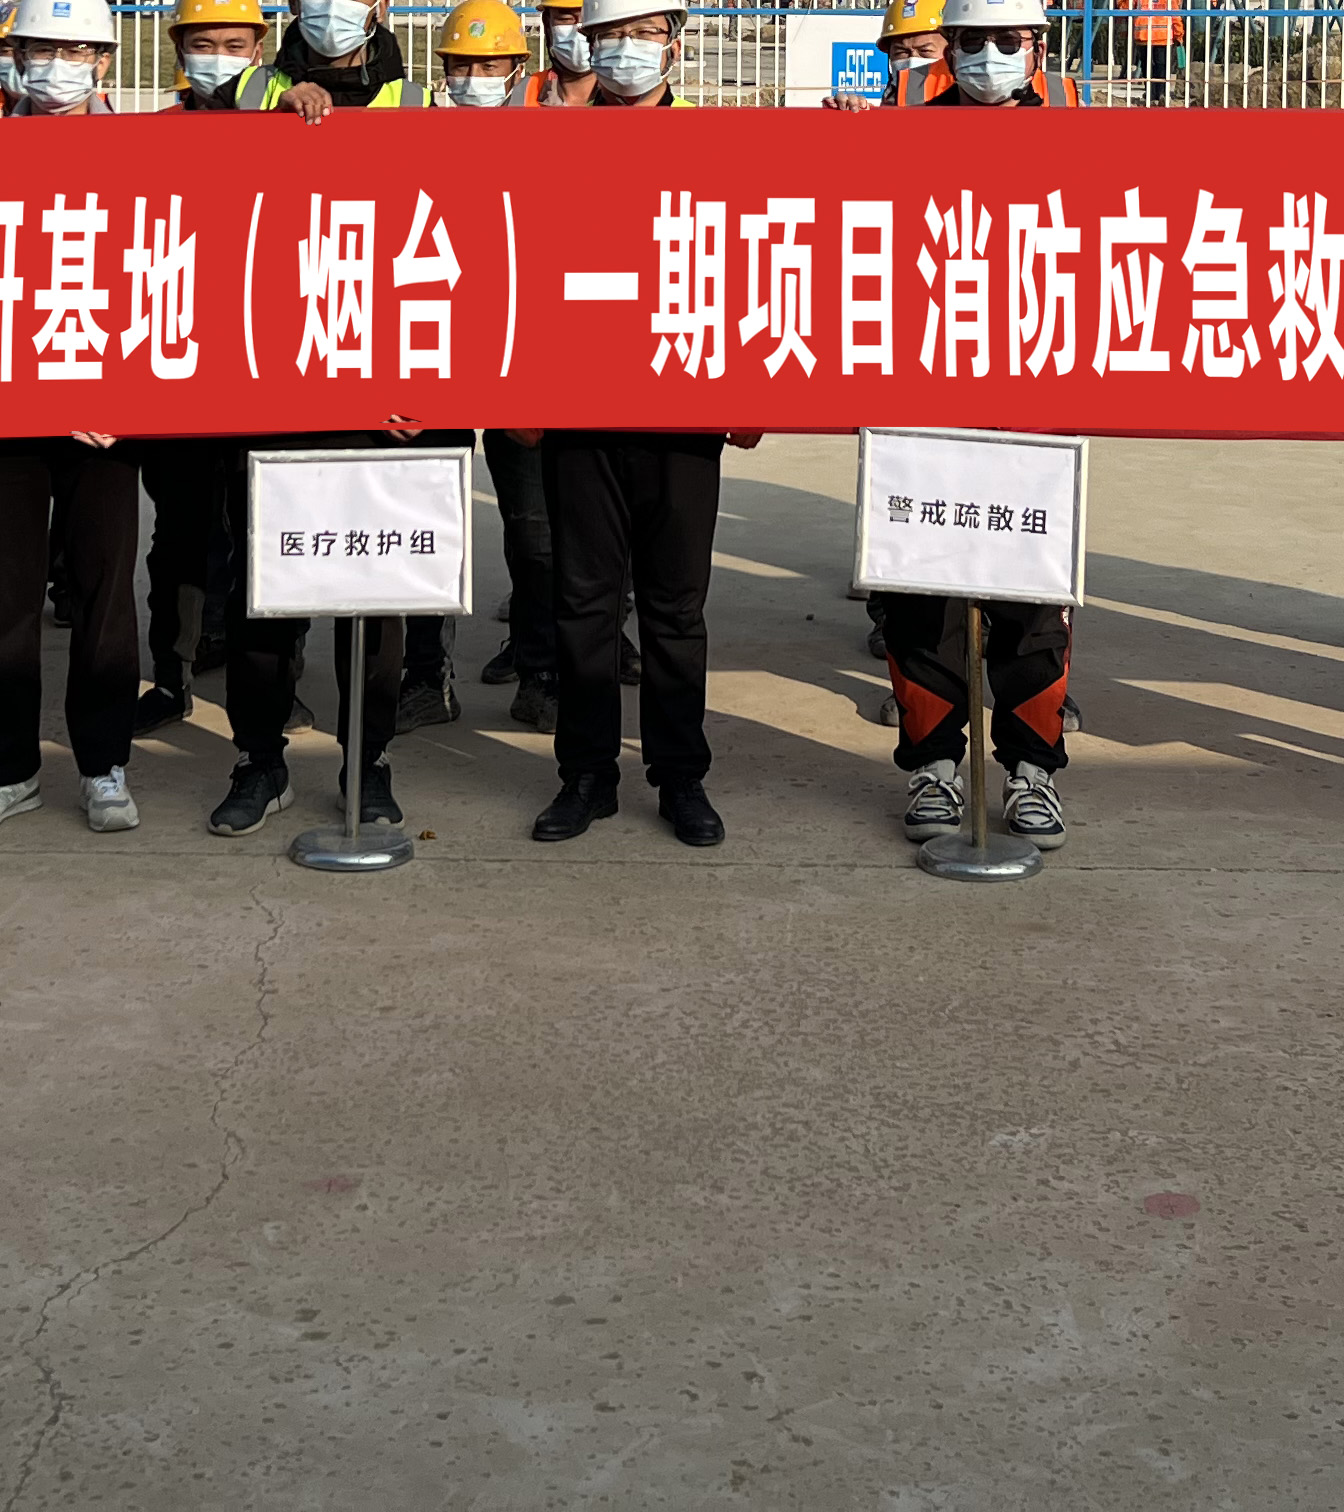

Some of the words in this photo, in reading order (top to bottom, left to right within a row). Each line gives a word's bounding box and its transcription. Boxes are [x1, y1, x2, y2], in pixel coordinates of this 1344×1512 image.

[887, 495, 1048, 535] 警戒疏散组
[280, 529, 436, 557] 医疗救护组
